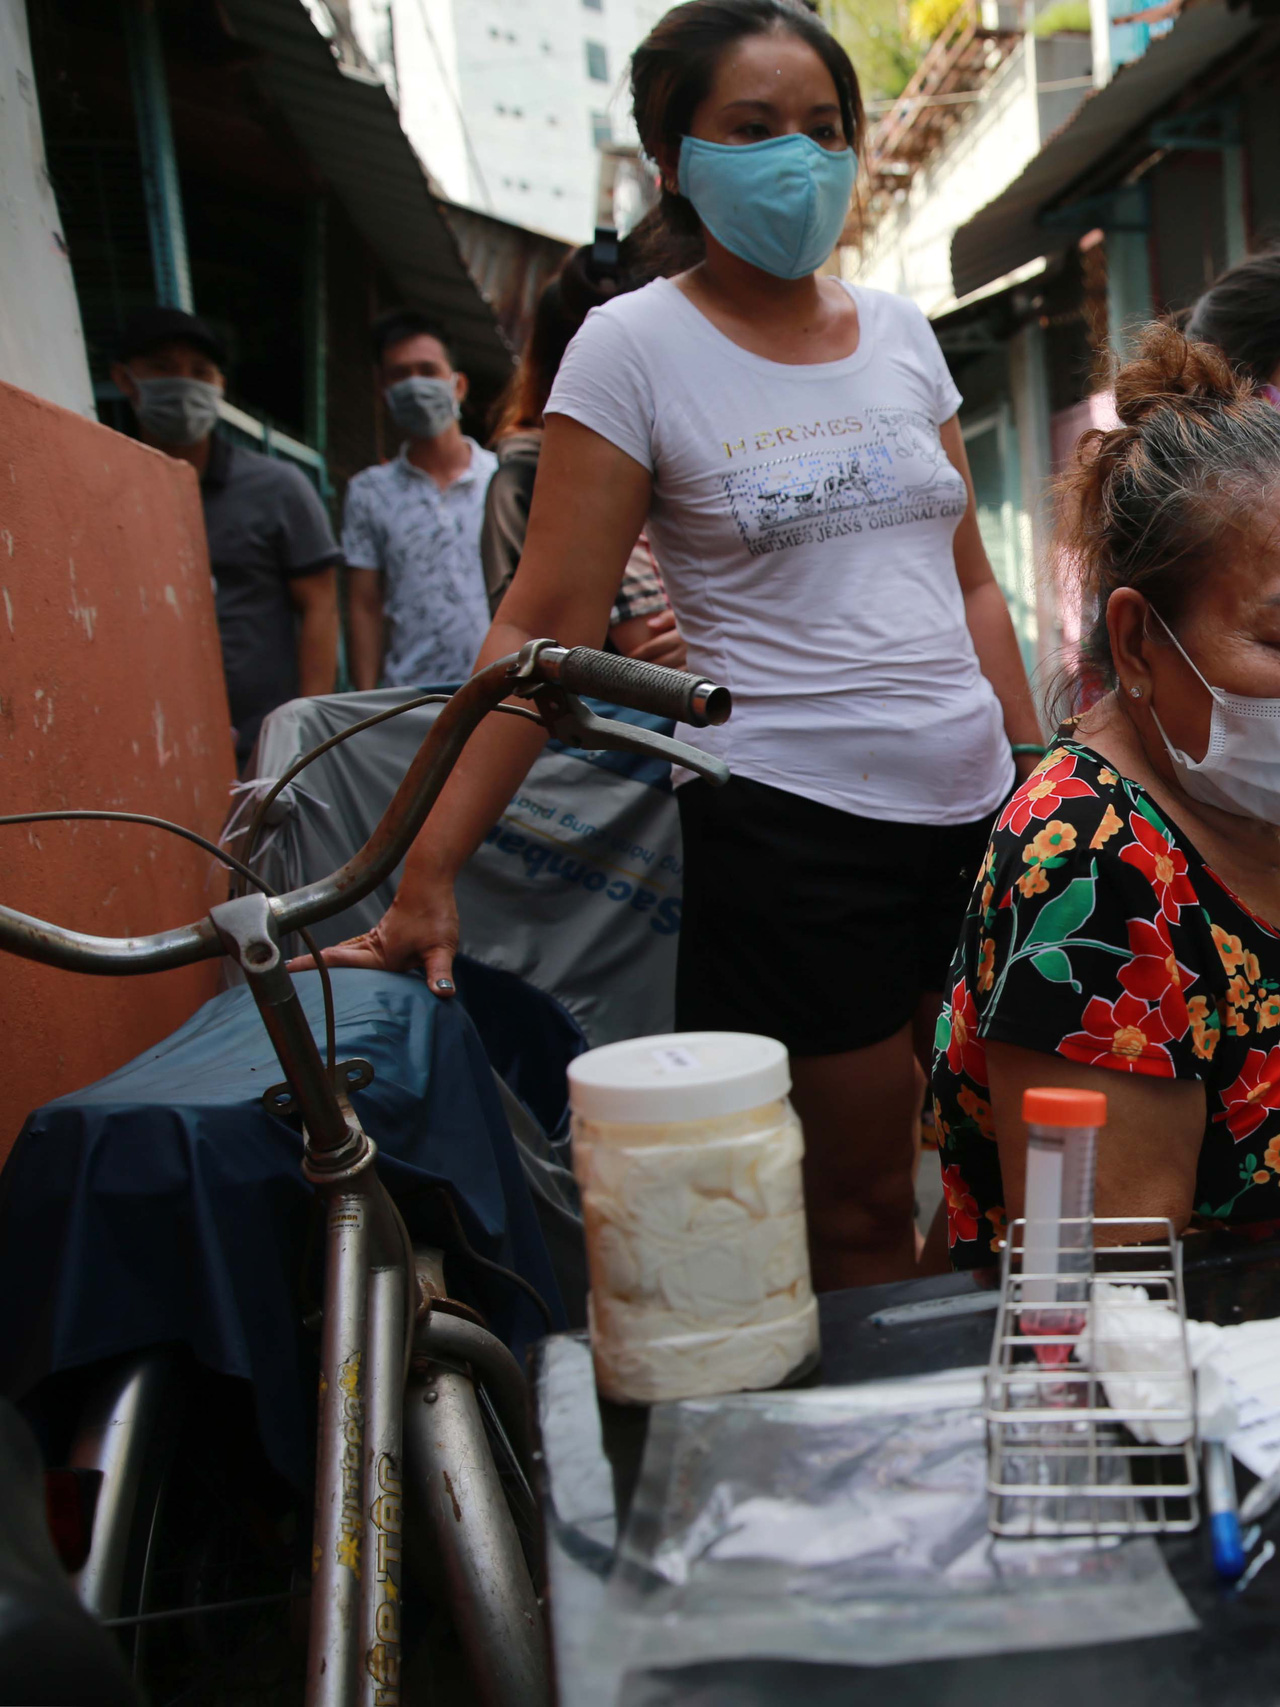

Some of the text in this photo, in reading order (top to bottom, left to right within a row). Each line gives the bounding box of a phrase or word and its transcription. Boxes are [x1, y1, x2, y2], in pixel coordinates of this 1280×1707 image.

[723, 416, 863, 458] HERMES
[816, 519, 862, 543] JEANS
[869, 507, 936, 530] ORIGINAL
